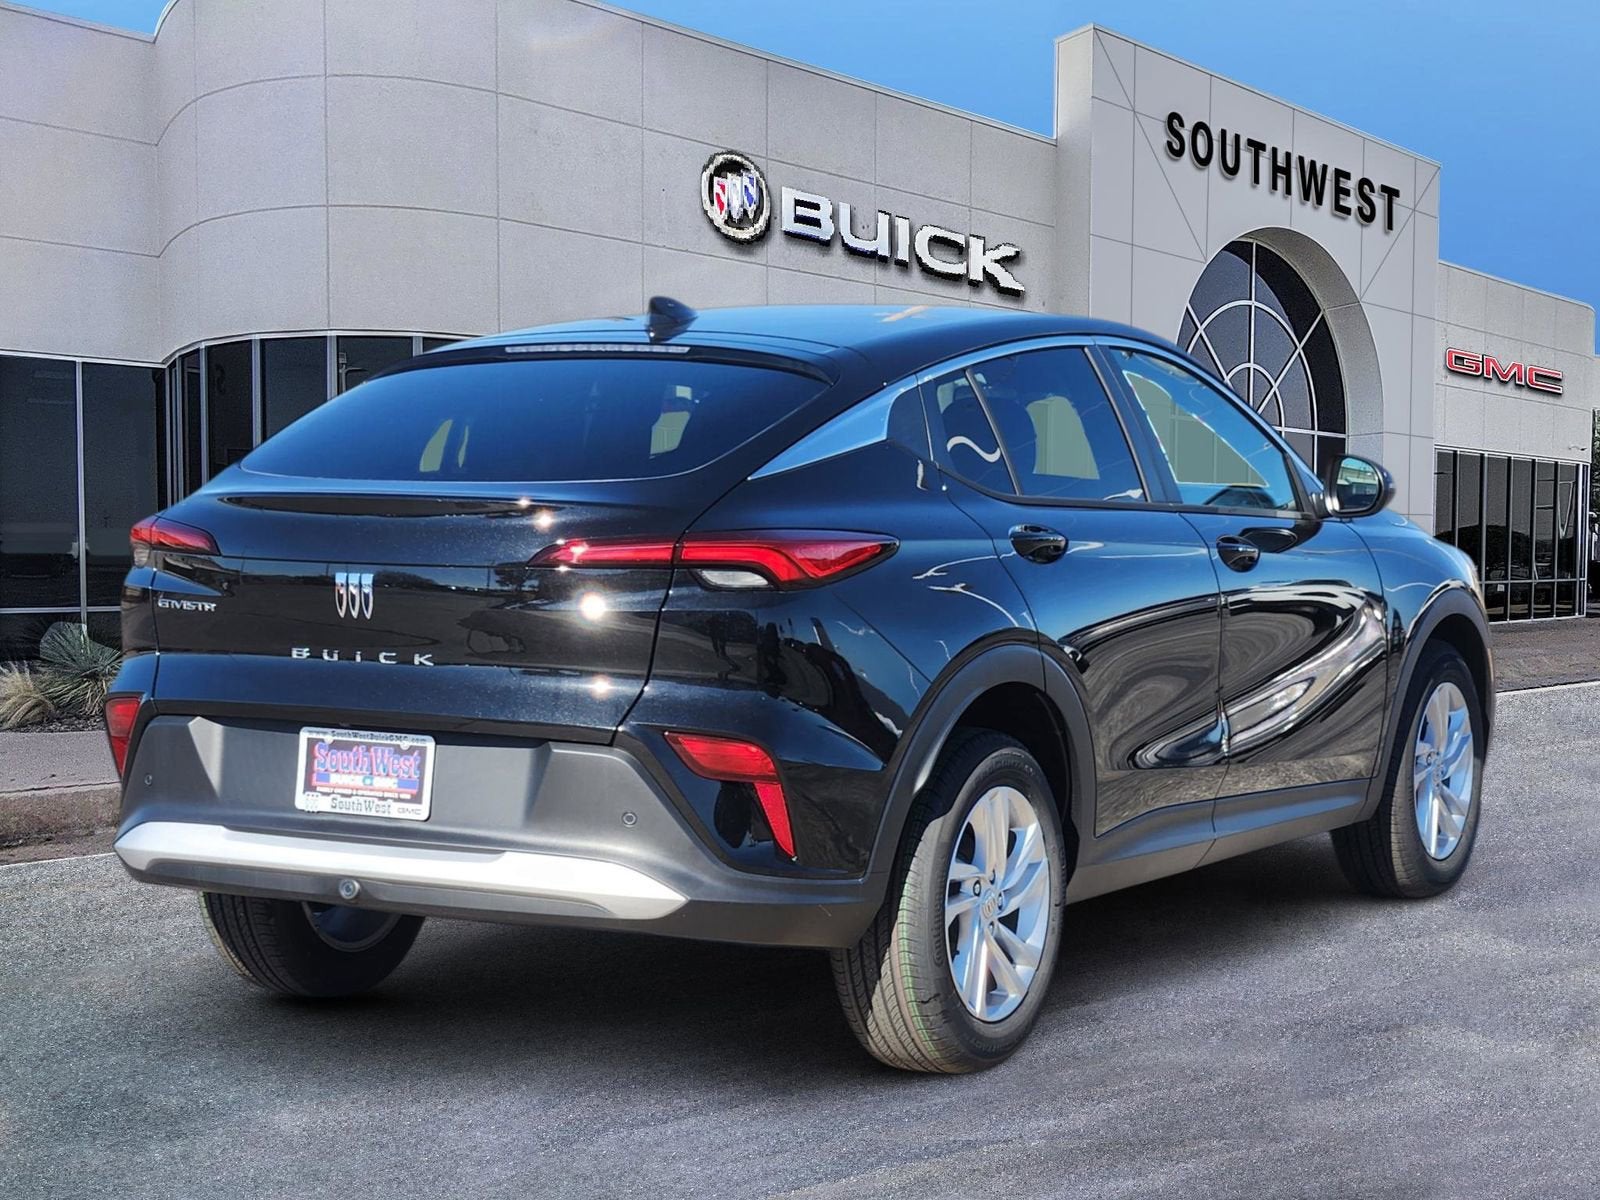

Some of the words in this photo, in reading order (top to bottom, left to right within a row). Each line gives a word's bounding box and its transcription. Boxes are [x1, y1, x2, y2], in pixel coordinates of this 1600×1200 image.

[1166, 111, 1400, 232] SOUTHWEST
[781, 186, 1026, 297] BUICK
[1446, 347, 1564, 394] GMC
[291, 647, 434, 666] BUICK
[313, 741, 421, 778] SouthWest
[331, 797, 392, 815] SouthWest
